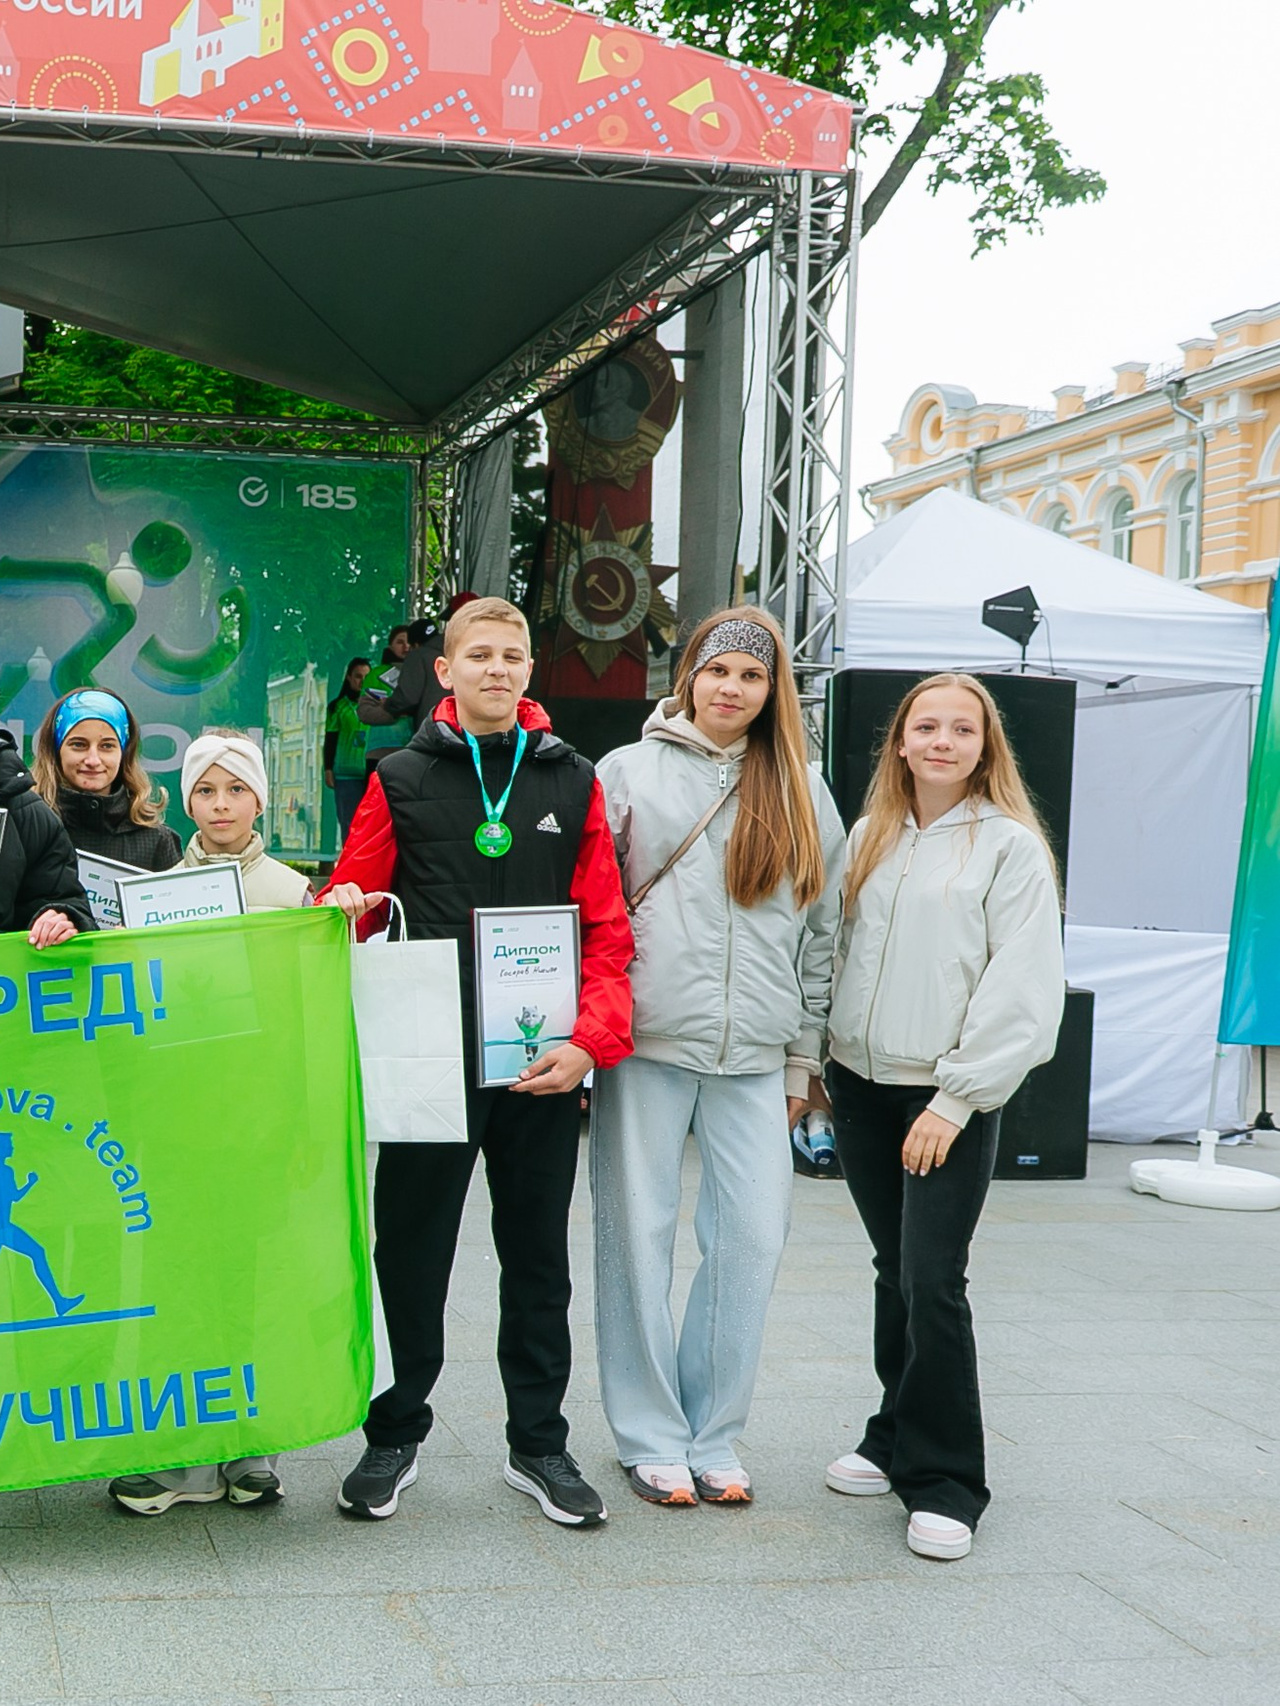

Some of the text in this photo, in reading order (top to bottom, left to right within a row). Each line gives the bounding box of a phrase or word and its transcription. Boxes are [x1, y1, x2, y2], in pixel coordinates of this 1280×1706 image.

[296, 484, 357, 510] 185
[536, 823, 562, 834] adidas
[85, 889, 120, 909] Дип
[144, 904, 223, 926] Диплом
[493, 945, 561, 959] Диплом
[83, 1118, 153, 1234] team
